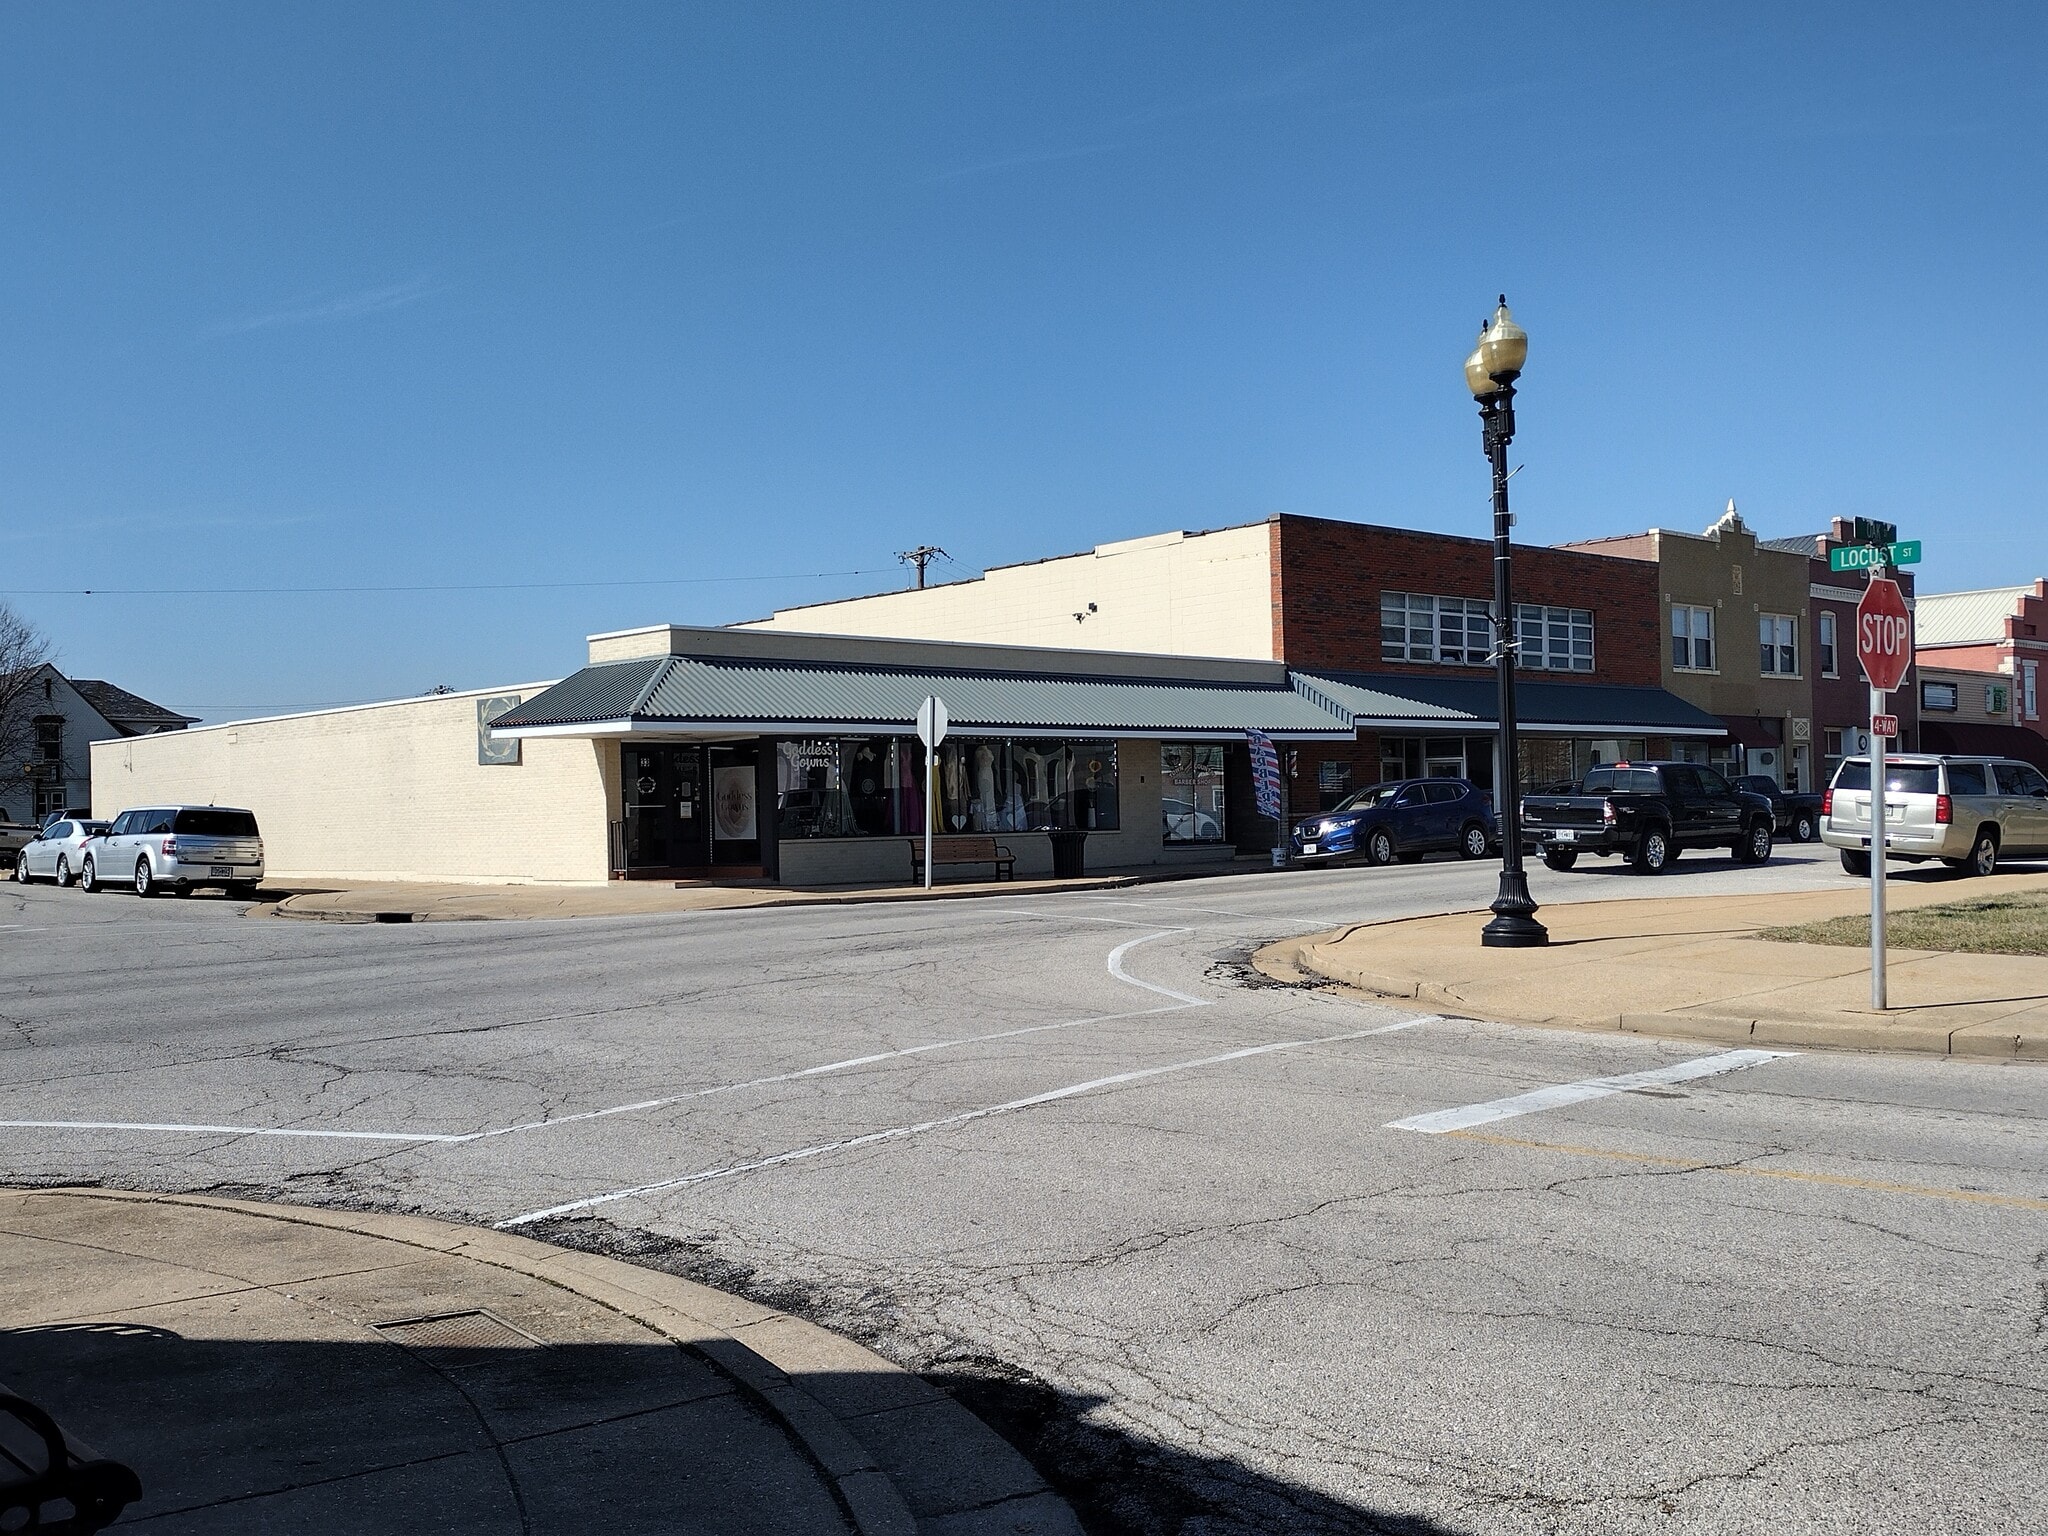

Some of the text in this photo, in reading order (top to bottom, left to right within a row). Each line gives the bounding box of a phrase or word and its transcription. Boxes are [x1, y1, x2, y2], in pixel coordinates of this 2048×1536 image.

[1840, 545, 1913, 568] LOCUST ST
[1861, 612, 1907, 656] STOP
[1874, 719, 1896, 734] 4-WAY
[783, 739, 833, 759] Goddess
[790, 754, 830, 772] Gowns
